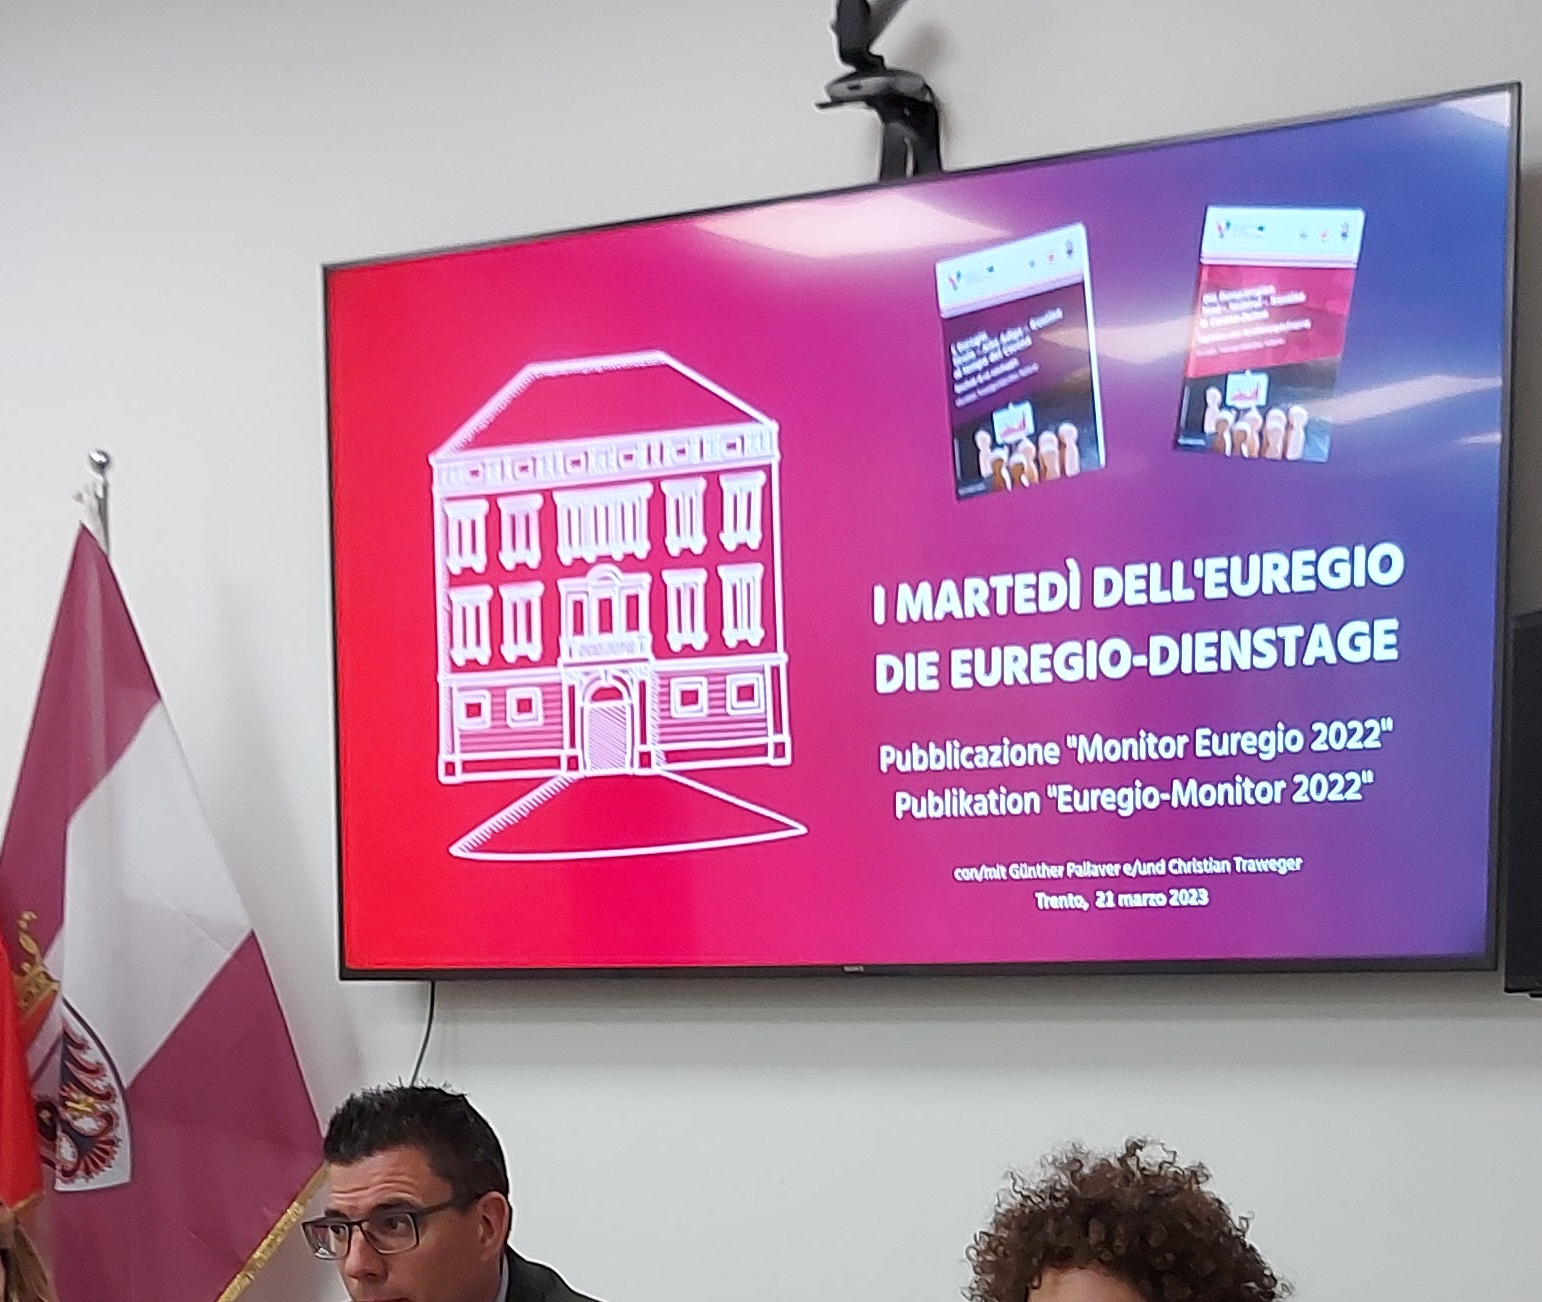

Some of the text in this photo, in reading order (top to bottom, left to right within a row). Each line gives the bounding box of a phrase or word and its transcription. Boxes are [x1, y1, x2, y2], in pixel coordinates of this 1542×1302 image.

[873, 541, 1405, 625] I MARTEDÌ DELL'EUREGIO
[875, 617, 1400, 694] DIE EUREGIO-DIENSTAGE
[879, 716, 1394, 773] Pubblicazione "Monitor Euregio 2022"
[895, 769, 1375, 819] Publikation "Euregio-Monitor 2022"
[1009, 862, 1064, 880] Günther
[1066, 860, 1121, 879] Pallaver
[1123, 858, 1166, 878] e/und
[1168, 857, 1232, 875] Christian
[1234, 856, 1304, 876] Traweger
[1035, 888, 1209, 911] Trento, 21 marzo 2023
